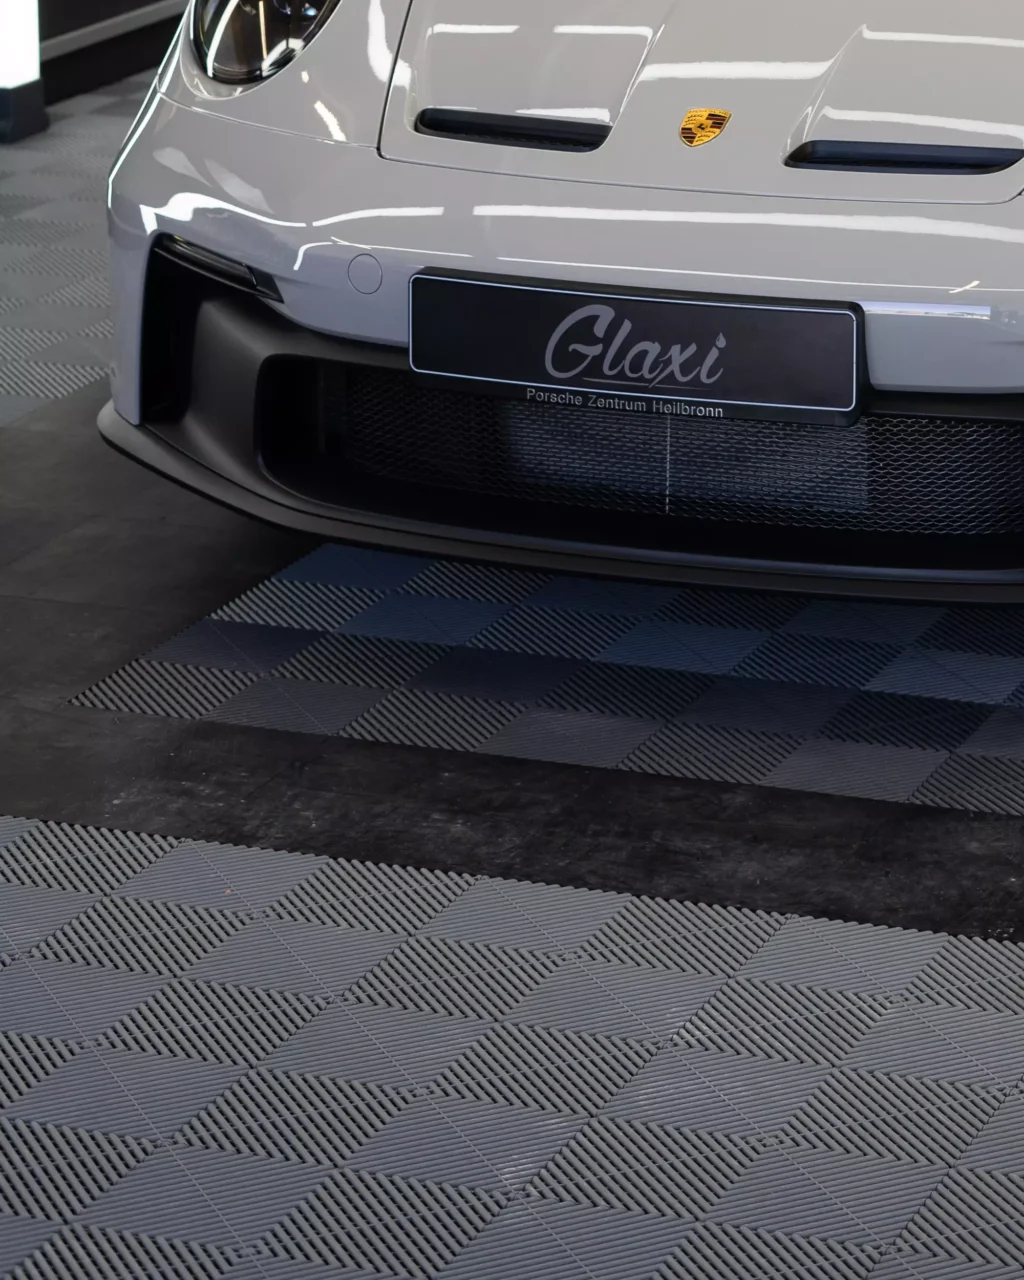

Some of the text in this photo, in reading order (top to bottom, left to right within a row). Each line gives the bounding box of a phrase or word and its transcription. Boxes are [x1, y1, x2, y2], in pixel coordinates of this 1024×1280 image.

[545, 304, 726, 389] Glaxi
[526, 387, 723, 418] Porsche Zentrum Heilbronn
